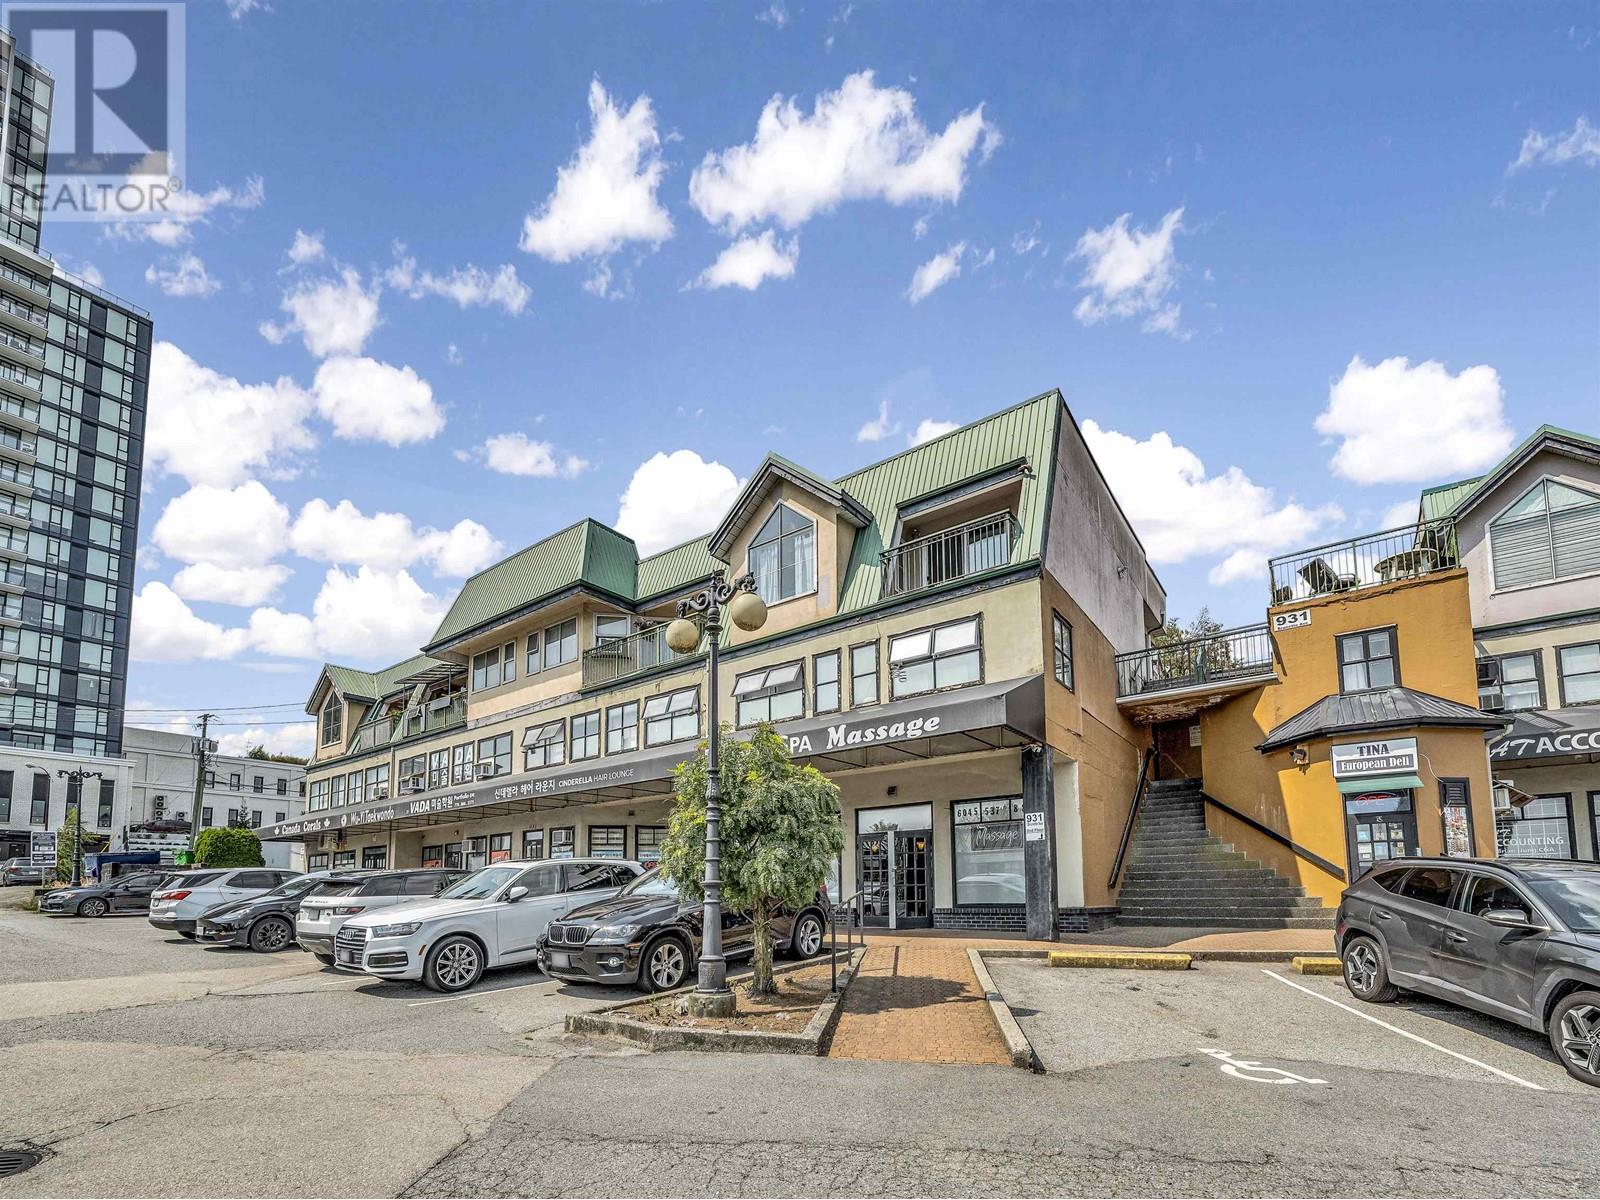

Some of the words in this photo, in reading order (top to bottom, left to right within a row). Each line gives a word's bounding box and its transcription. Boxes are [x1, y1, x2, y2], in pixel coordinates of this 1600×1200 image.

[1276, 611, 1308, 625] 931
[826, 716, 941, 750] Massage
[1357, 743, 1390, 757] TINA
[1341, 758, 1387, 771] European
[1389, 756, 1410, 767] Deli
[558, 775, 593, 788] CINDERELLA
[593, 772, 608, 783] HAIR
[608, 768, 635, 780] LOUNGE
[410, 800, 430, 814] VADA
[1026, 813, 1042, 822] 931
[281, 823, 301, 835] Canada
[303, 819, 322, 832] Corals
[976, 826, 1019, 847] Massage
[1496, 836, 1564, 847] CCOUNTING
